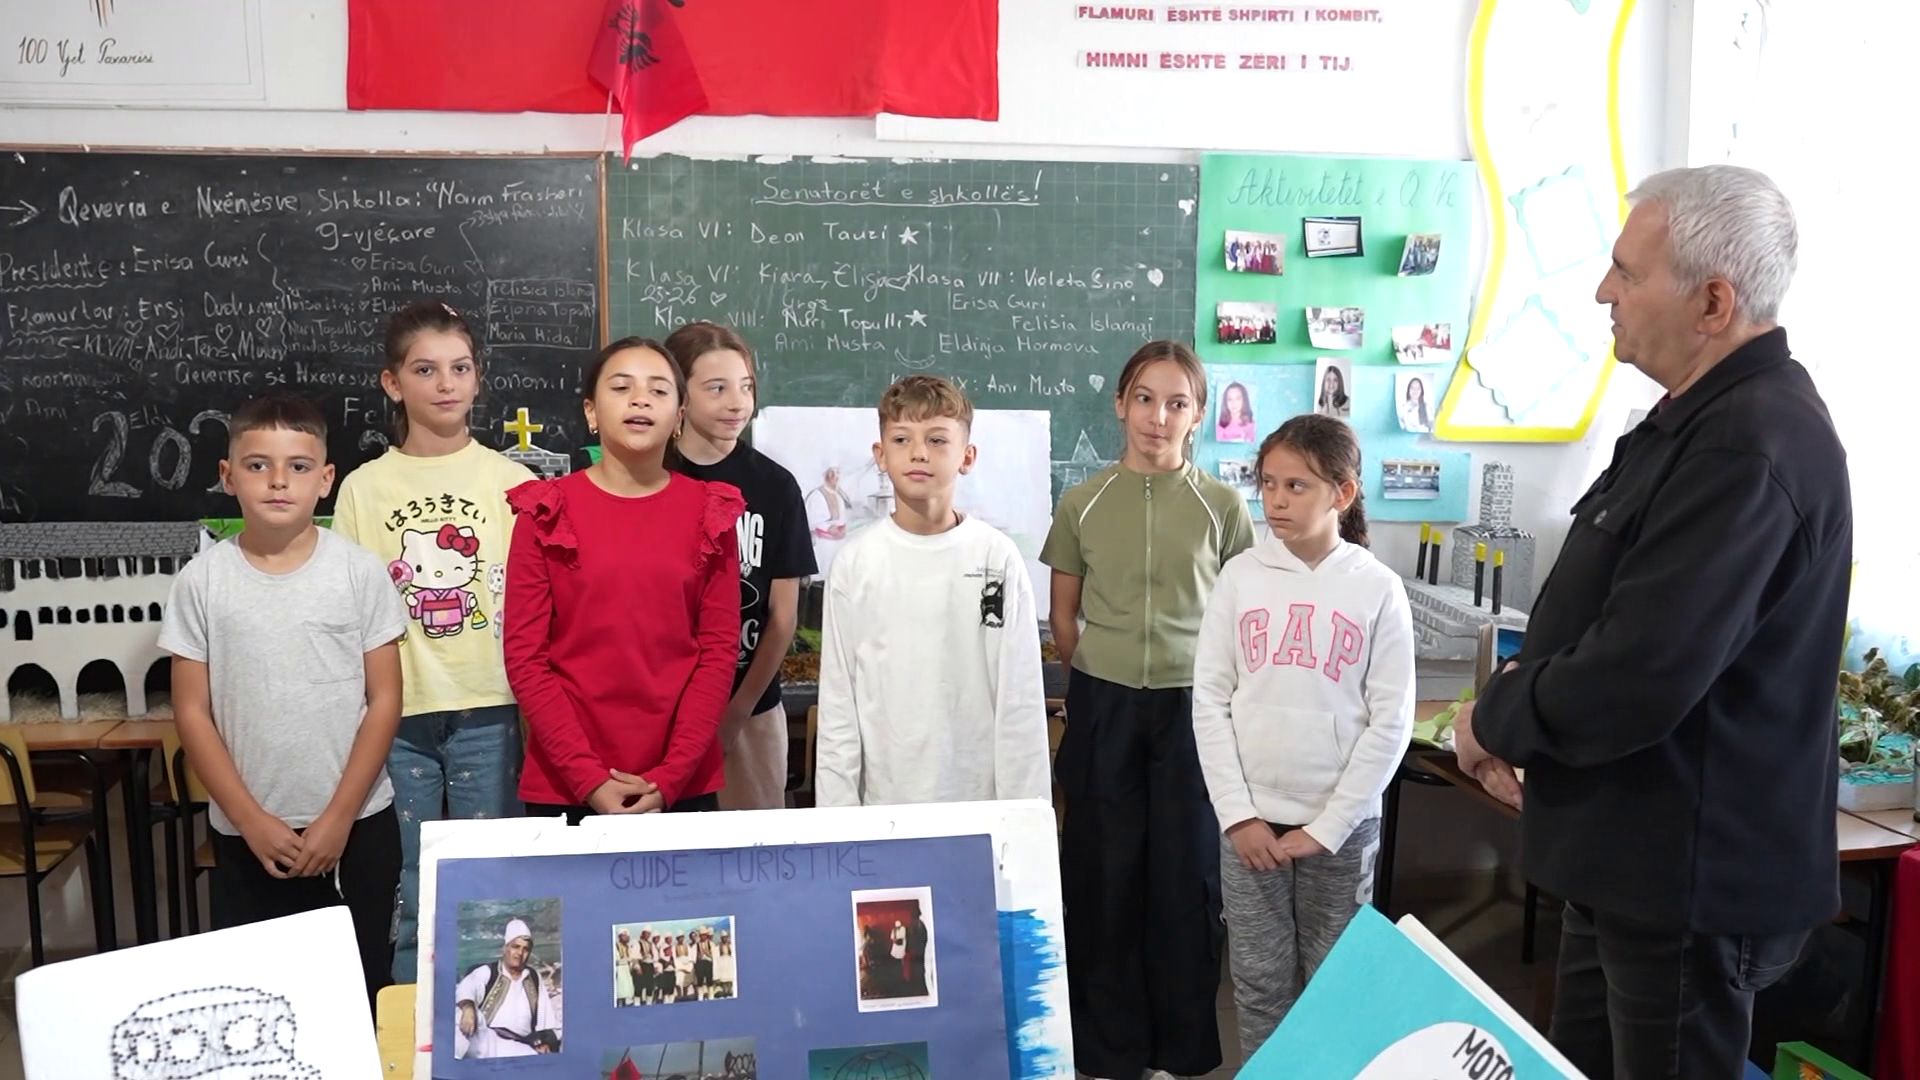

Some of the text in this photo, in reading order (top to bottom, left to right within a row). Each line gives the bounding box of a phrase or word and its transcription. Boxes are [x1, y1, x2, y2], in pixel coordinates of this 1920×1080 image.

[1078, 6, 1154, 22] FLAMURI
[1228, 9, 1295, 22] SHPIRTI
[18, 36, 48, 65] 100
[1086, 52, 1148, 68] HIMNI
[1238, 53, 1286, 70] ZËRI
[901, 187, 914, 201] e
[58, 185, 148, 229] Qeveria
[161, 201, 177, 215] e
[318, 186, 421, 214] Shkolla:
[622, 217, 684, 240] Klasa
[751, 221, 806, 245] Dean
[132, 246, 194, 274] Erisa
[1025, 268, 1088, 288] Violeta
[952, 292, 1000, 311] Erisa
[1012, 316, 1078, 334] Felisia
[1239, 603, 1364, 683] GAP
[610, 855, 689, 890] GUIDE
